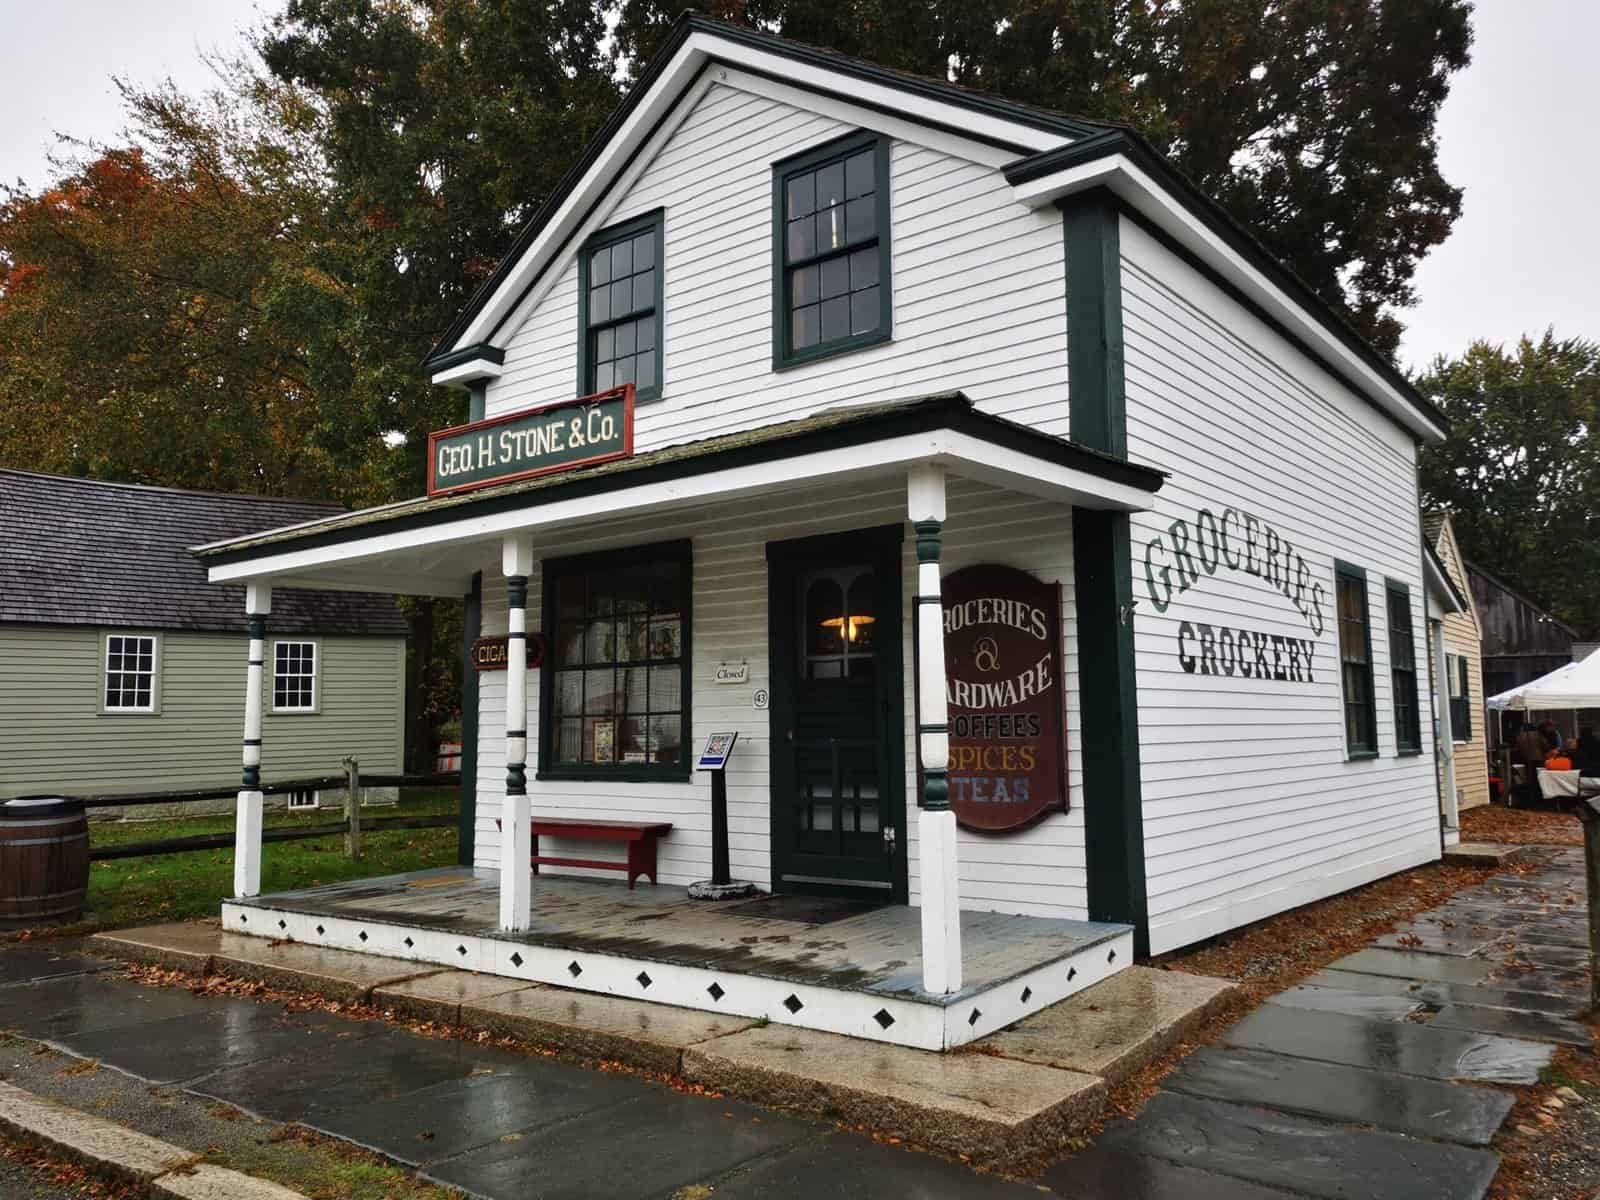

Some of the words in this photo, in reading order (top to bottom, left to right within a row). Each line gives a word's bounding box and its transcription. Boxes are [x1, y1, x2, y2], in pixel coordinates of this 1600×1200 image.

[438, 445, 474, 477] GEO.
[478, 435, 496, 469] H.
[500, 422, 565, 464] STONE
[1144, 508, 1325, 637] GROCERIES
[943, 598, 1047, 640] ROCERIES
[717, 668, 745, 679] Closed
[975, 636, 1000, 672] &
[1178, 621, 1314, 683] CROCKERY
[945, 652, 1053, 709] ARDWARE
[951, 777, 1031, 802] TEAS
